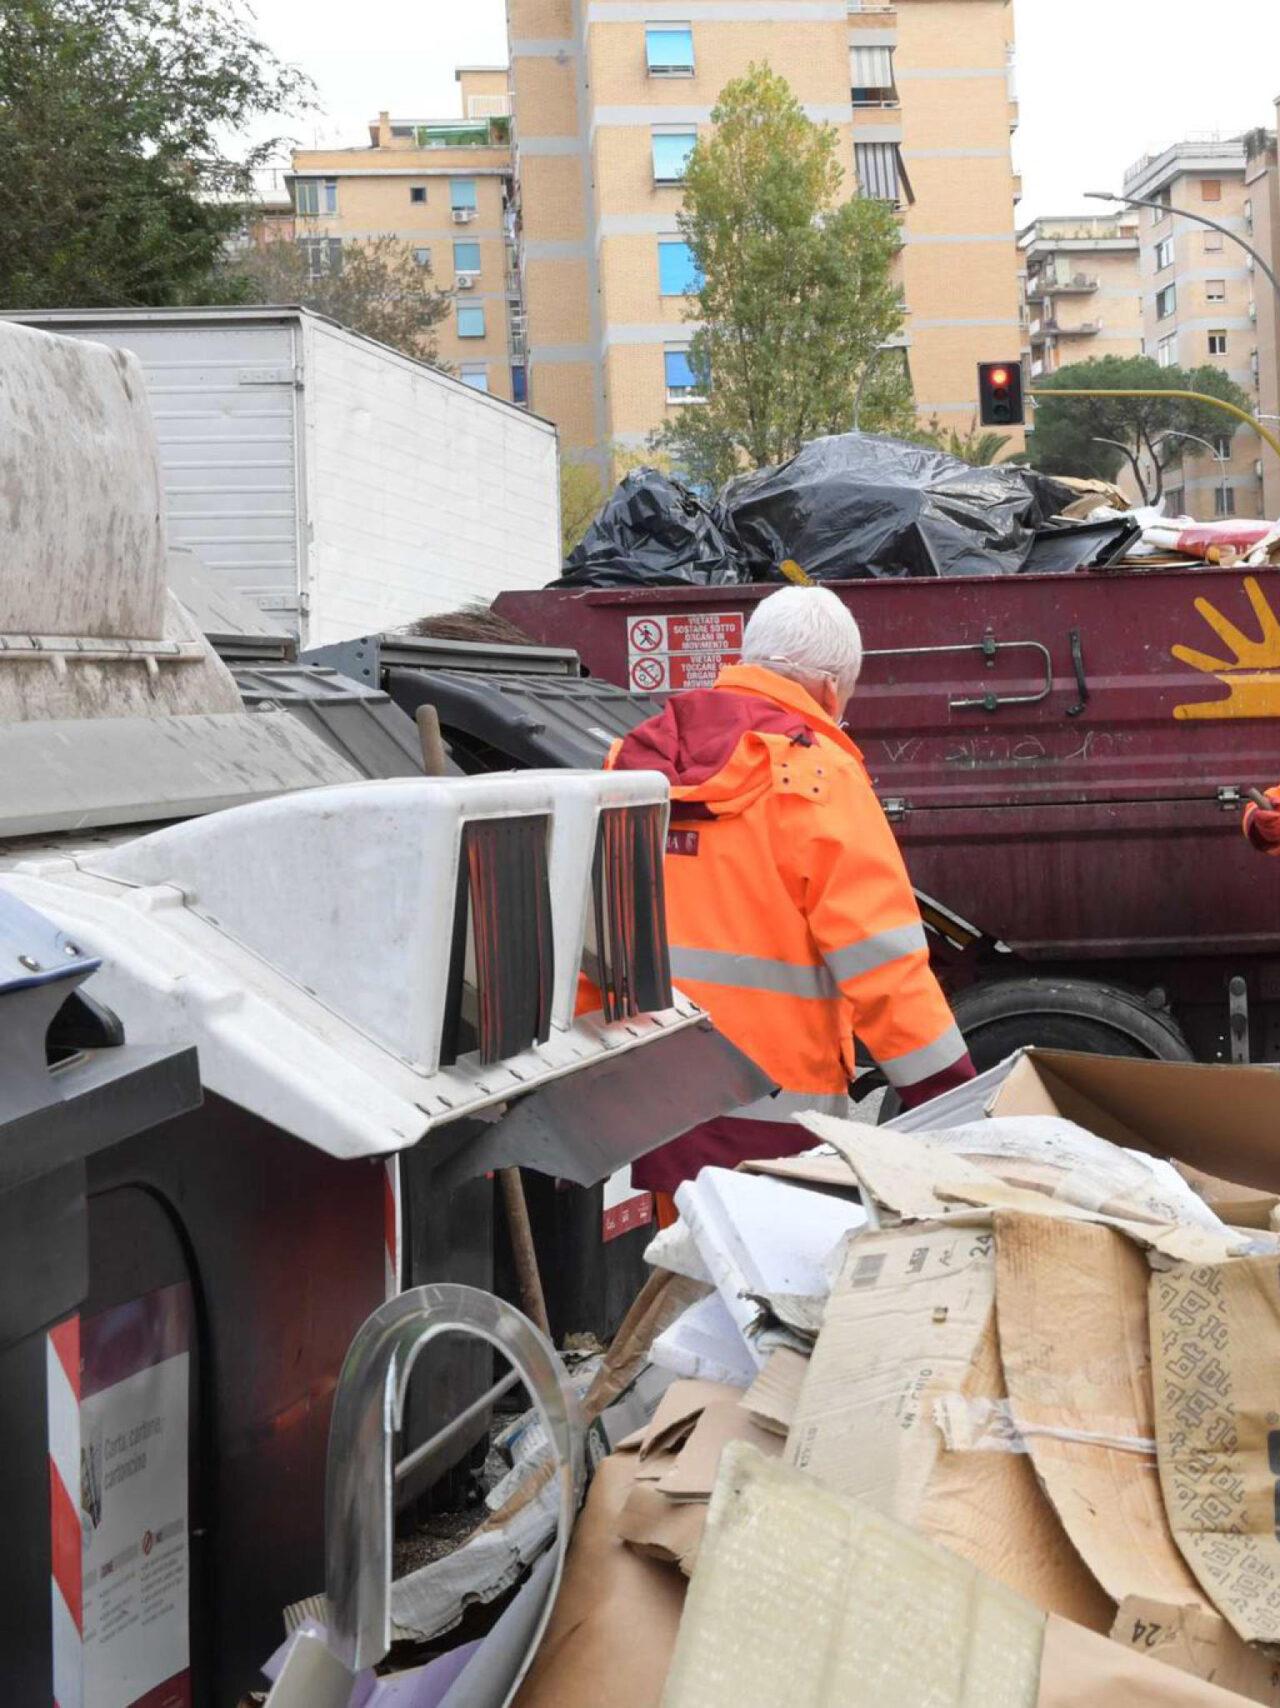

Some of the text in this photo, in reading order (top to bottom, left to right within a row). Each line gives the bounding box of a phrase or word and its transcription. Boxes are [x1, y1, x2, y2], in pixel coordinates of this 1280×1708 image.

[688, 615, 720, 624] VIETATO
[674, 623, 736, 634] SOSTARE SOTTO
[684, 633, 715, 641] ORGANI
[681, 640, 729, 650] MOVIMENTO
[690, 654, 722, 663] VIETATO
[682, 663, 717, 672] TOCCARE
[686, 671, 716, 680] ORGANI
[969, 1234, 994, 1257] 24
[1131, 1618, 1162, 1647] 24
